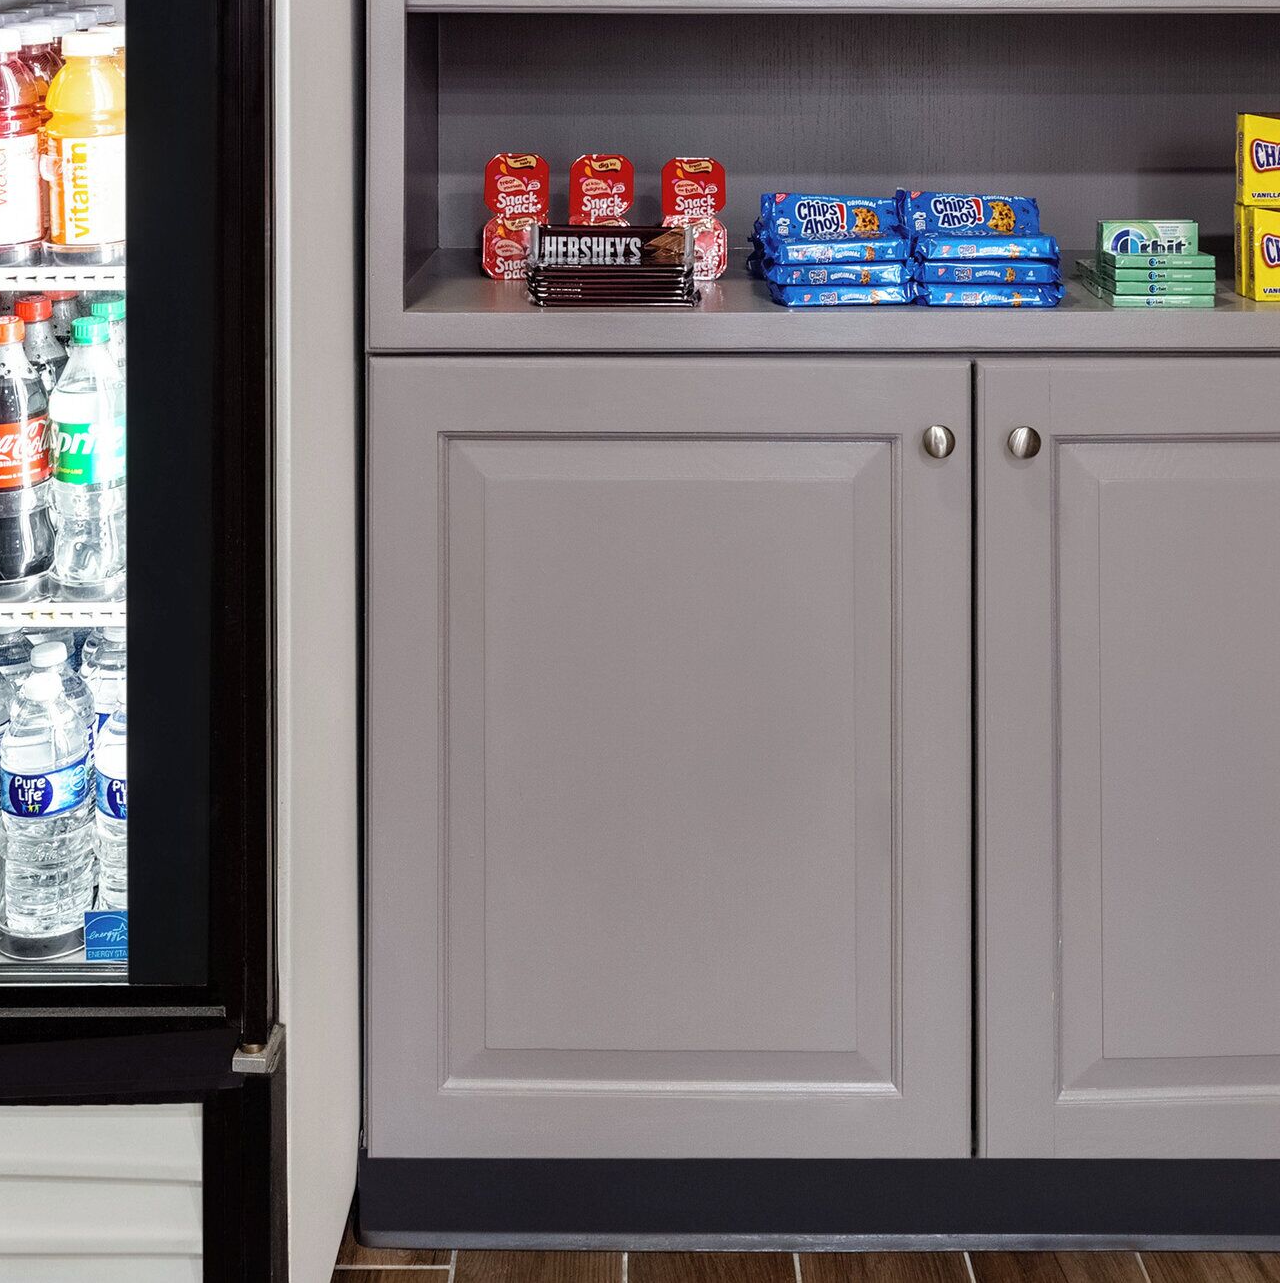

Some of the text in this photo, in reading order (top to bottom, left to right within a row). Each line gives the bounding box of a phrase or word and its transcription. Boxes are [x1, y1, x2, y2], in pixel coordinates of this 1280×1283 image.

[69, 142, 90, 238] vitamin
[496, 193, 537, 208] Snack
[675, 196, 715, 211] Snack
[931, 197, 974, 215] Chips
[797, 202, 837, 220] Chips
[544, 237, 642, 259] HERSHEY'S
[15, 776, 45, 789] Pure
